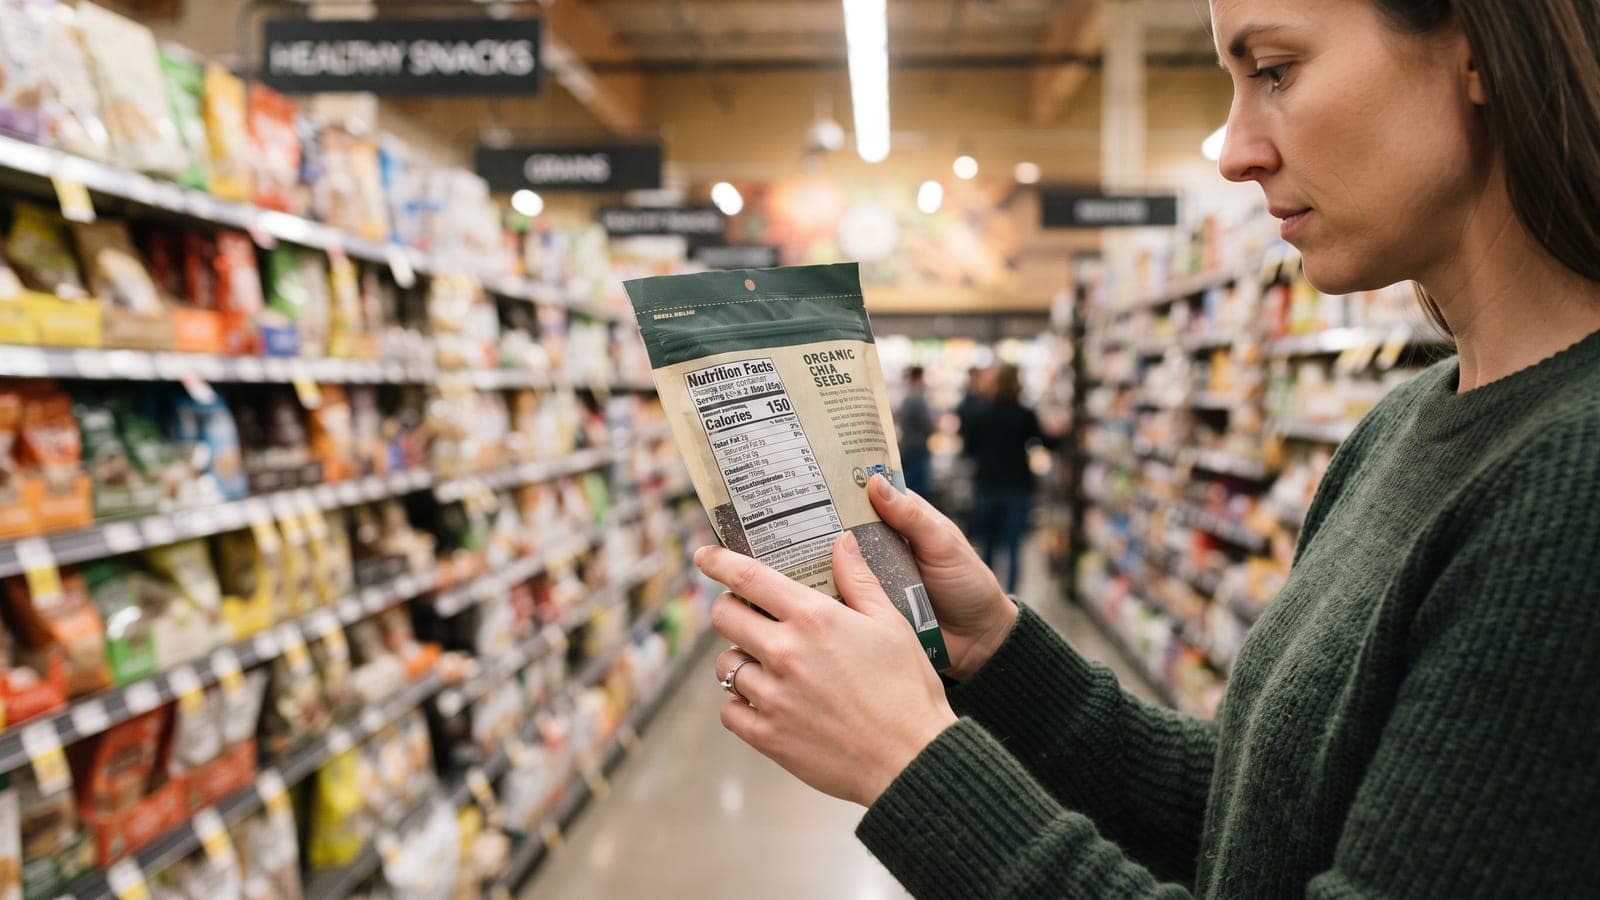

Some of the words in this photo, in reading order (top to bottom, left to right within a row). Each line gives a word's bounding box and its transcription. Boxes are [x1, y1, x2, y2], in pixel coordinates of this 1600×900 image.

[269, 41, 401, 75] HEALTHY
[408, 39, 534, 76] SNACKS
[803, 349, 855, 365] ORGANIC
[686, 366, 743, 388] Nutrition
[743, 360, 774, 375] Facts
[809, 363, 838, 377] CHIA
[814, 372, 853, 388] SEEDS
[705, 410, 753, 430] Calories
[767, 397, 791, 414] 150
[713, 439, 729, 449] Total
[730, 435, 741, 444] Fat
